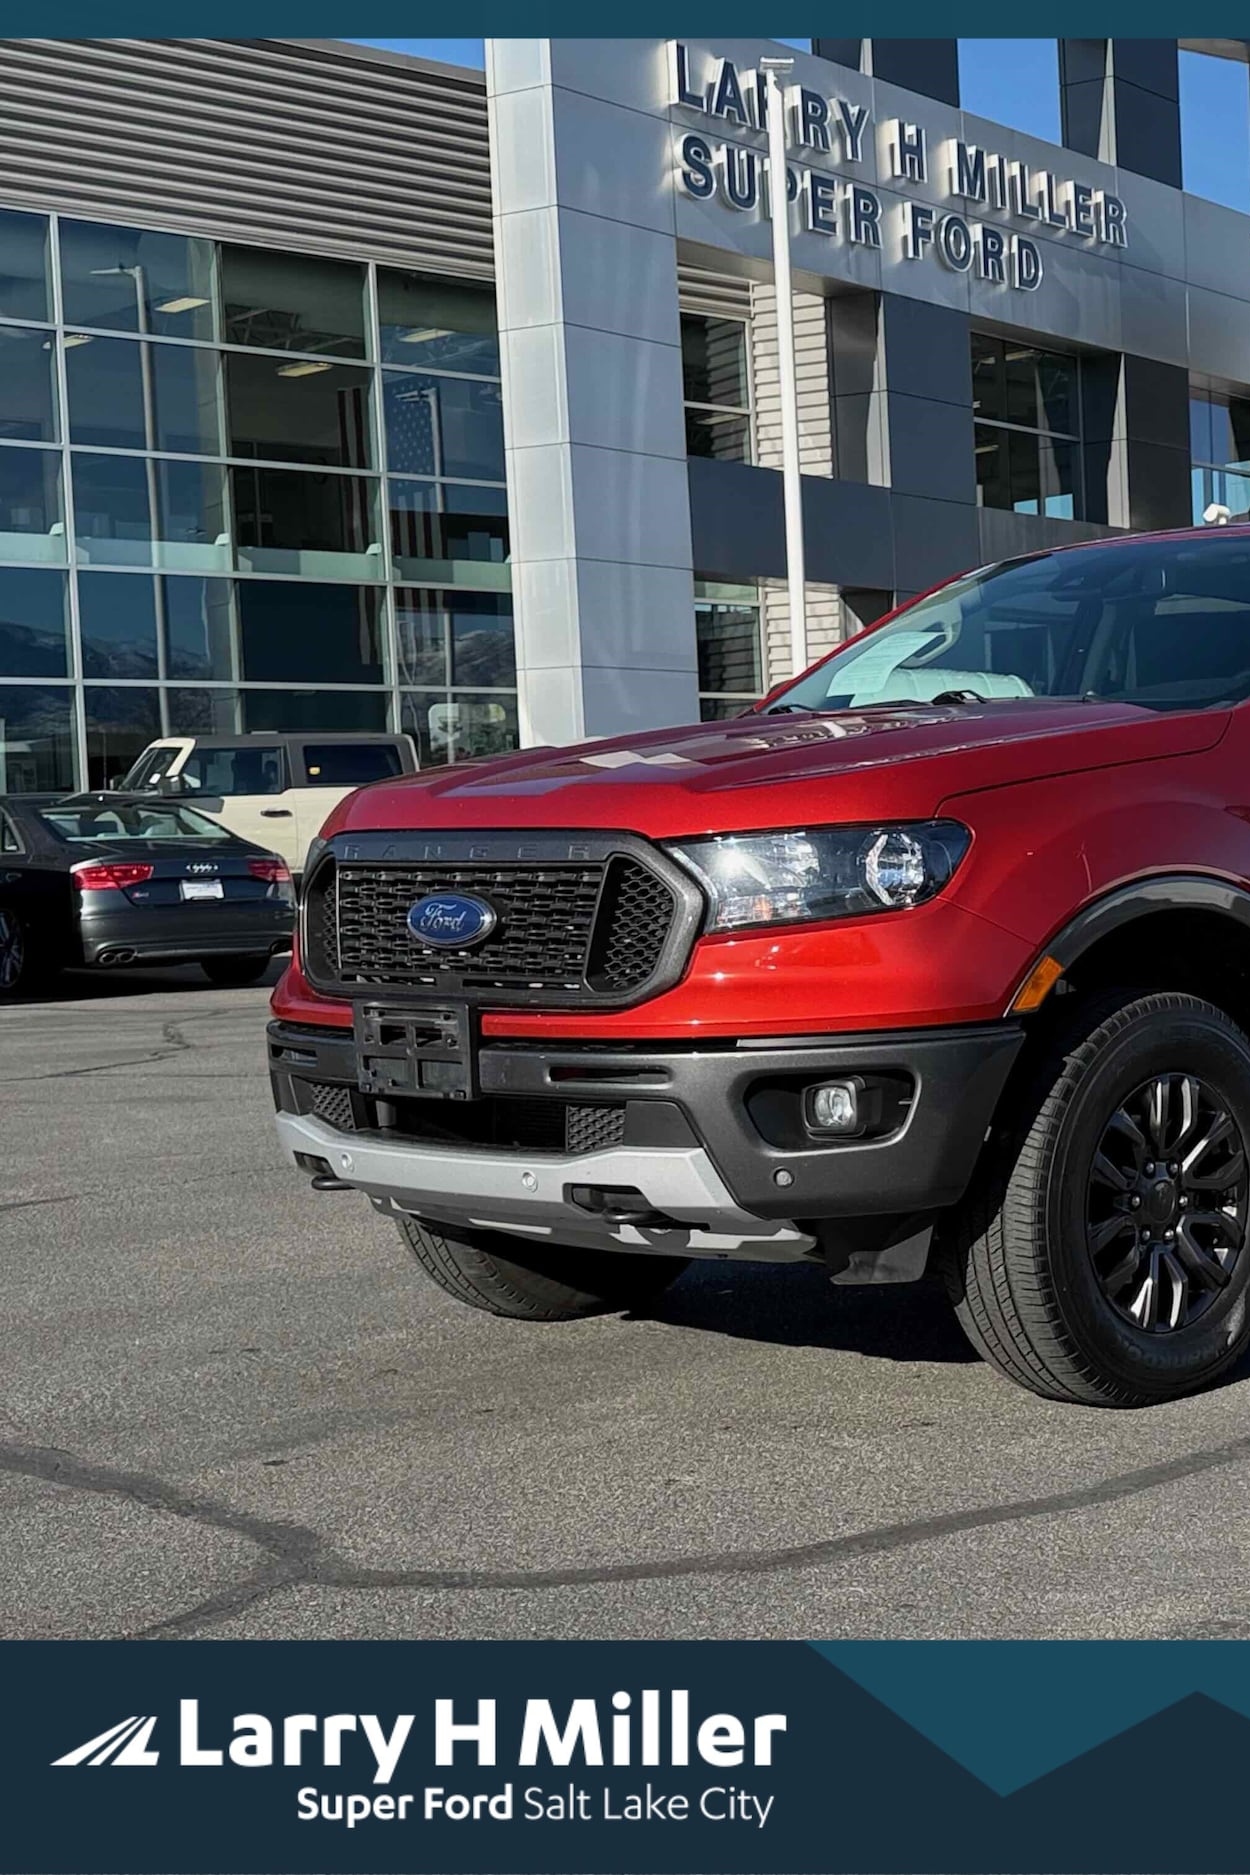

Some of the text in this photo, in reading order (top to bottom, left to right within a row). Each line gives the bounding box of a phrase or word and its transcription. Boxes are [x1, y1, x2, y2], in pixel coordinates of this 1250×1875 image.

[889, 117, 928, 184] H
[948, 137, 1129, 248] MILLER
[904, 200, 1044, 292] FORD
[344, 844, 589, 860] RANGER
[420, 903, 466, 932] Ford
